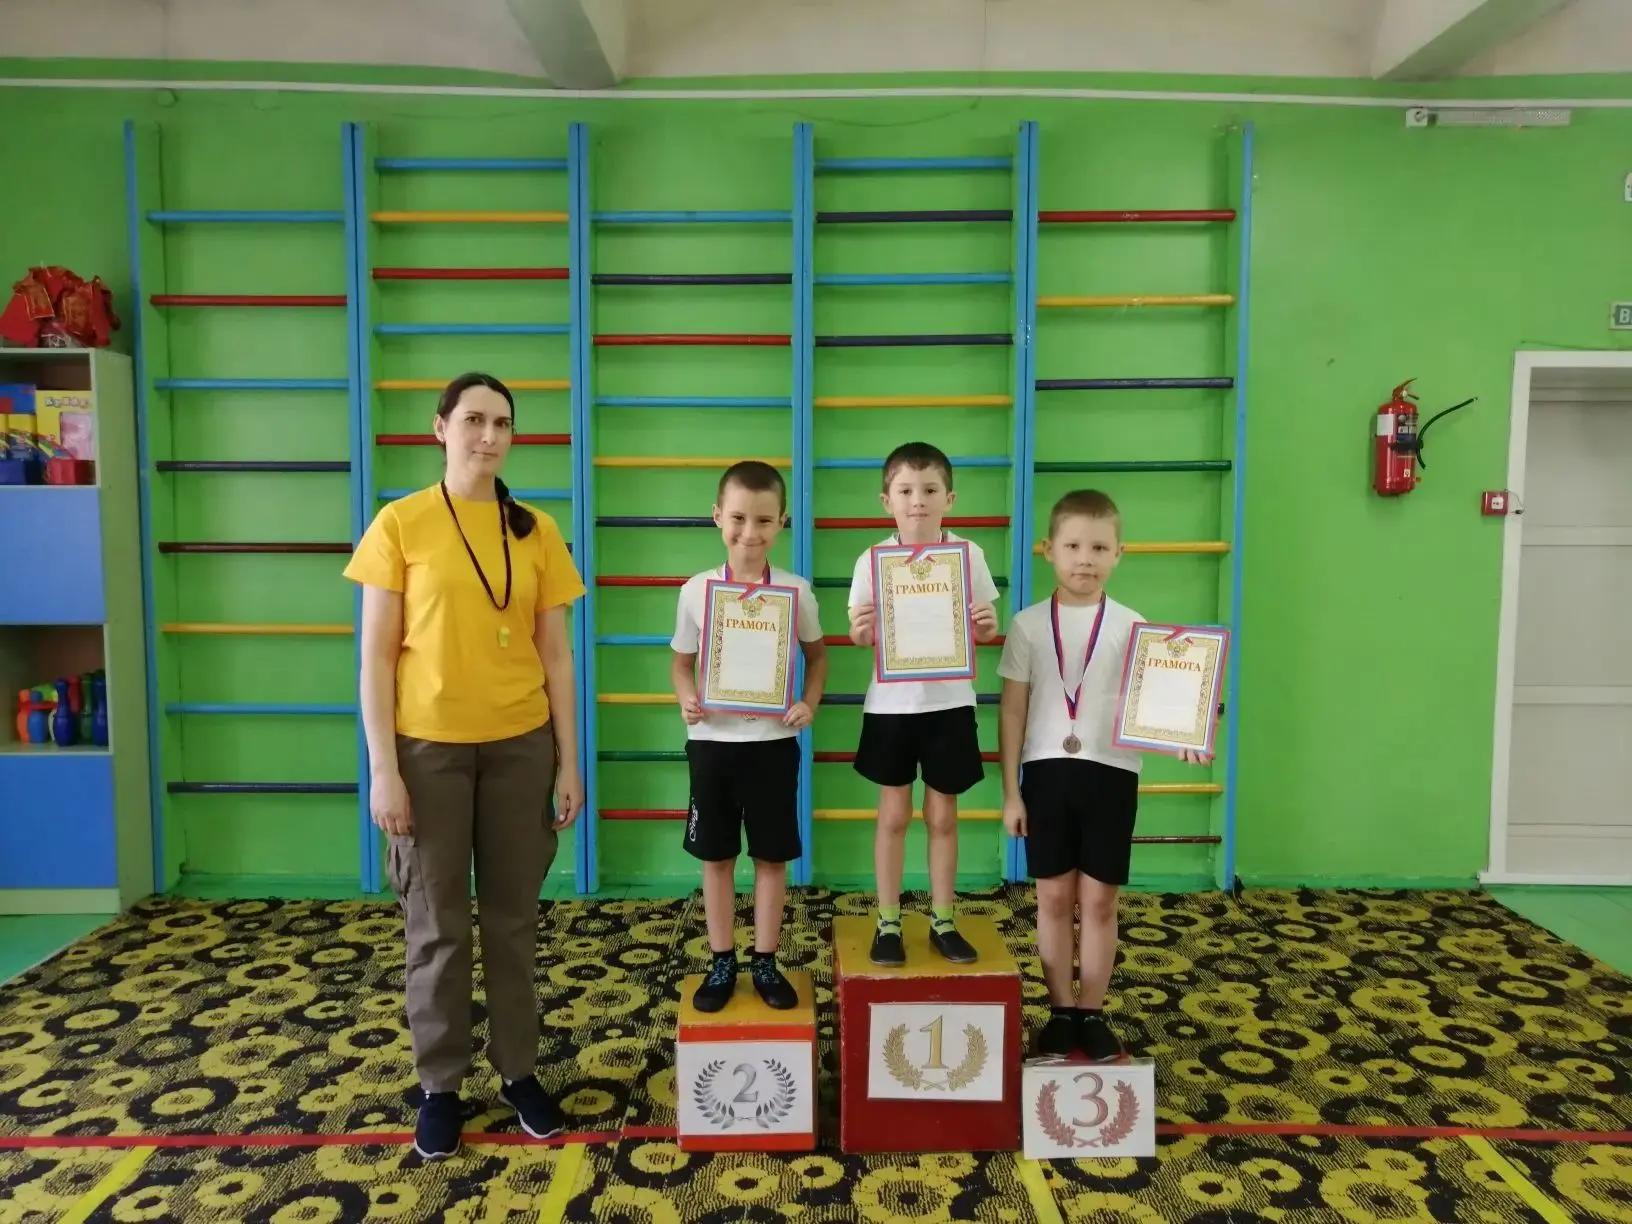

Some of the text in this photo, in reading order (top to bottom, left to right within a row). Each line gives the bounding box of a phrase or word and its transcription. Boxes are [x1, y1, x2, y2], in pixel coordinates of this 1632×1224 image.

[894, 582, 951, 595] ГРАМОТА
[725, 618, 777, 632] ГРАМОТА
[1147, 657, 1201, 672] ГРАМОТА
[919, 1014, 950, 1070] 1
[732, 1063, 759, 1103] 2
[1072, 1071, 1109, 1128] 3
